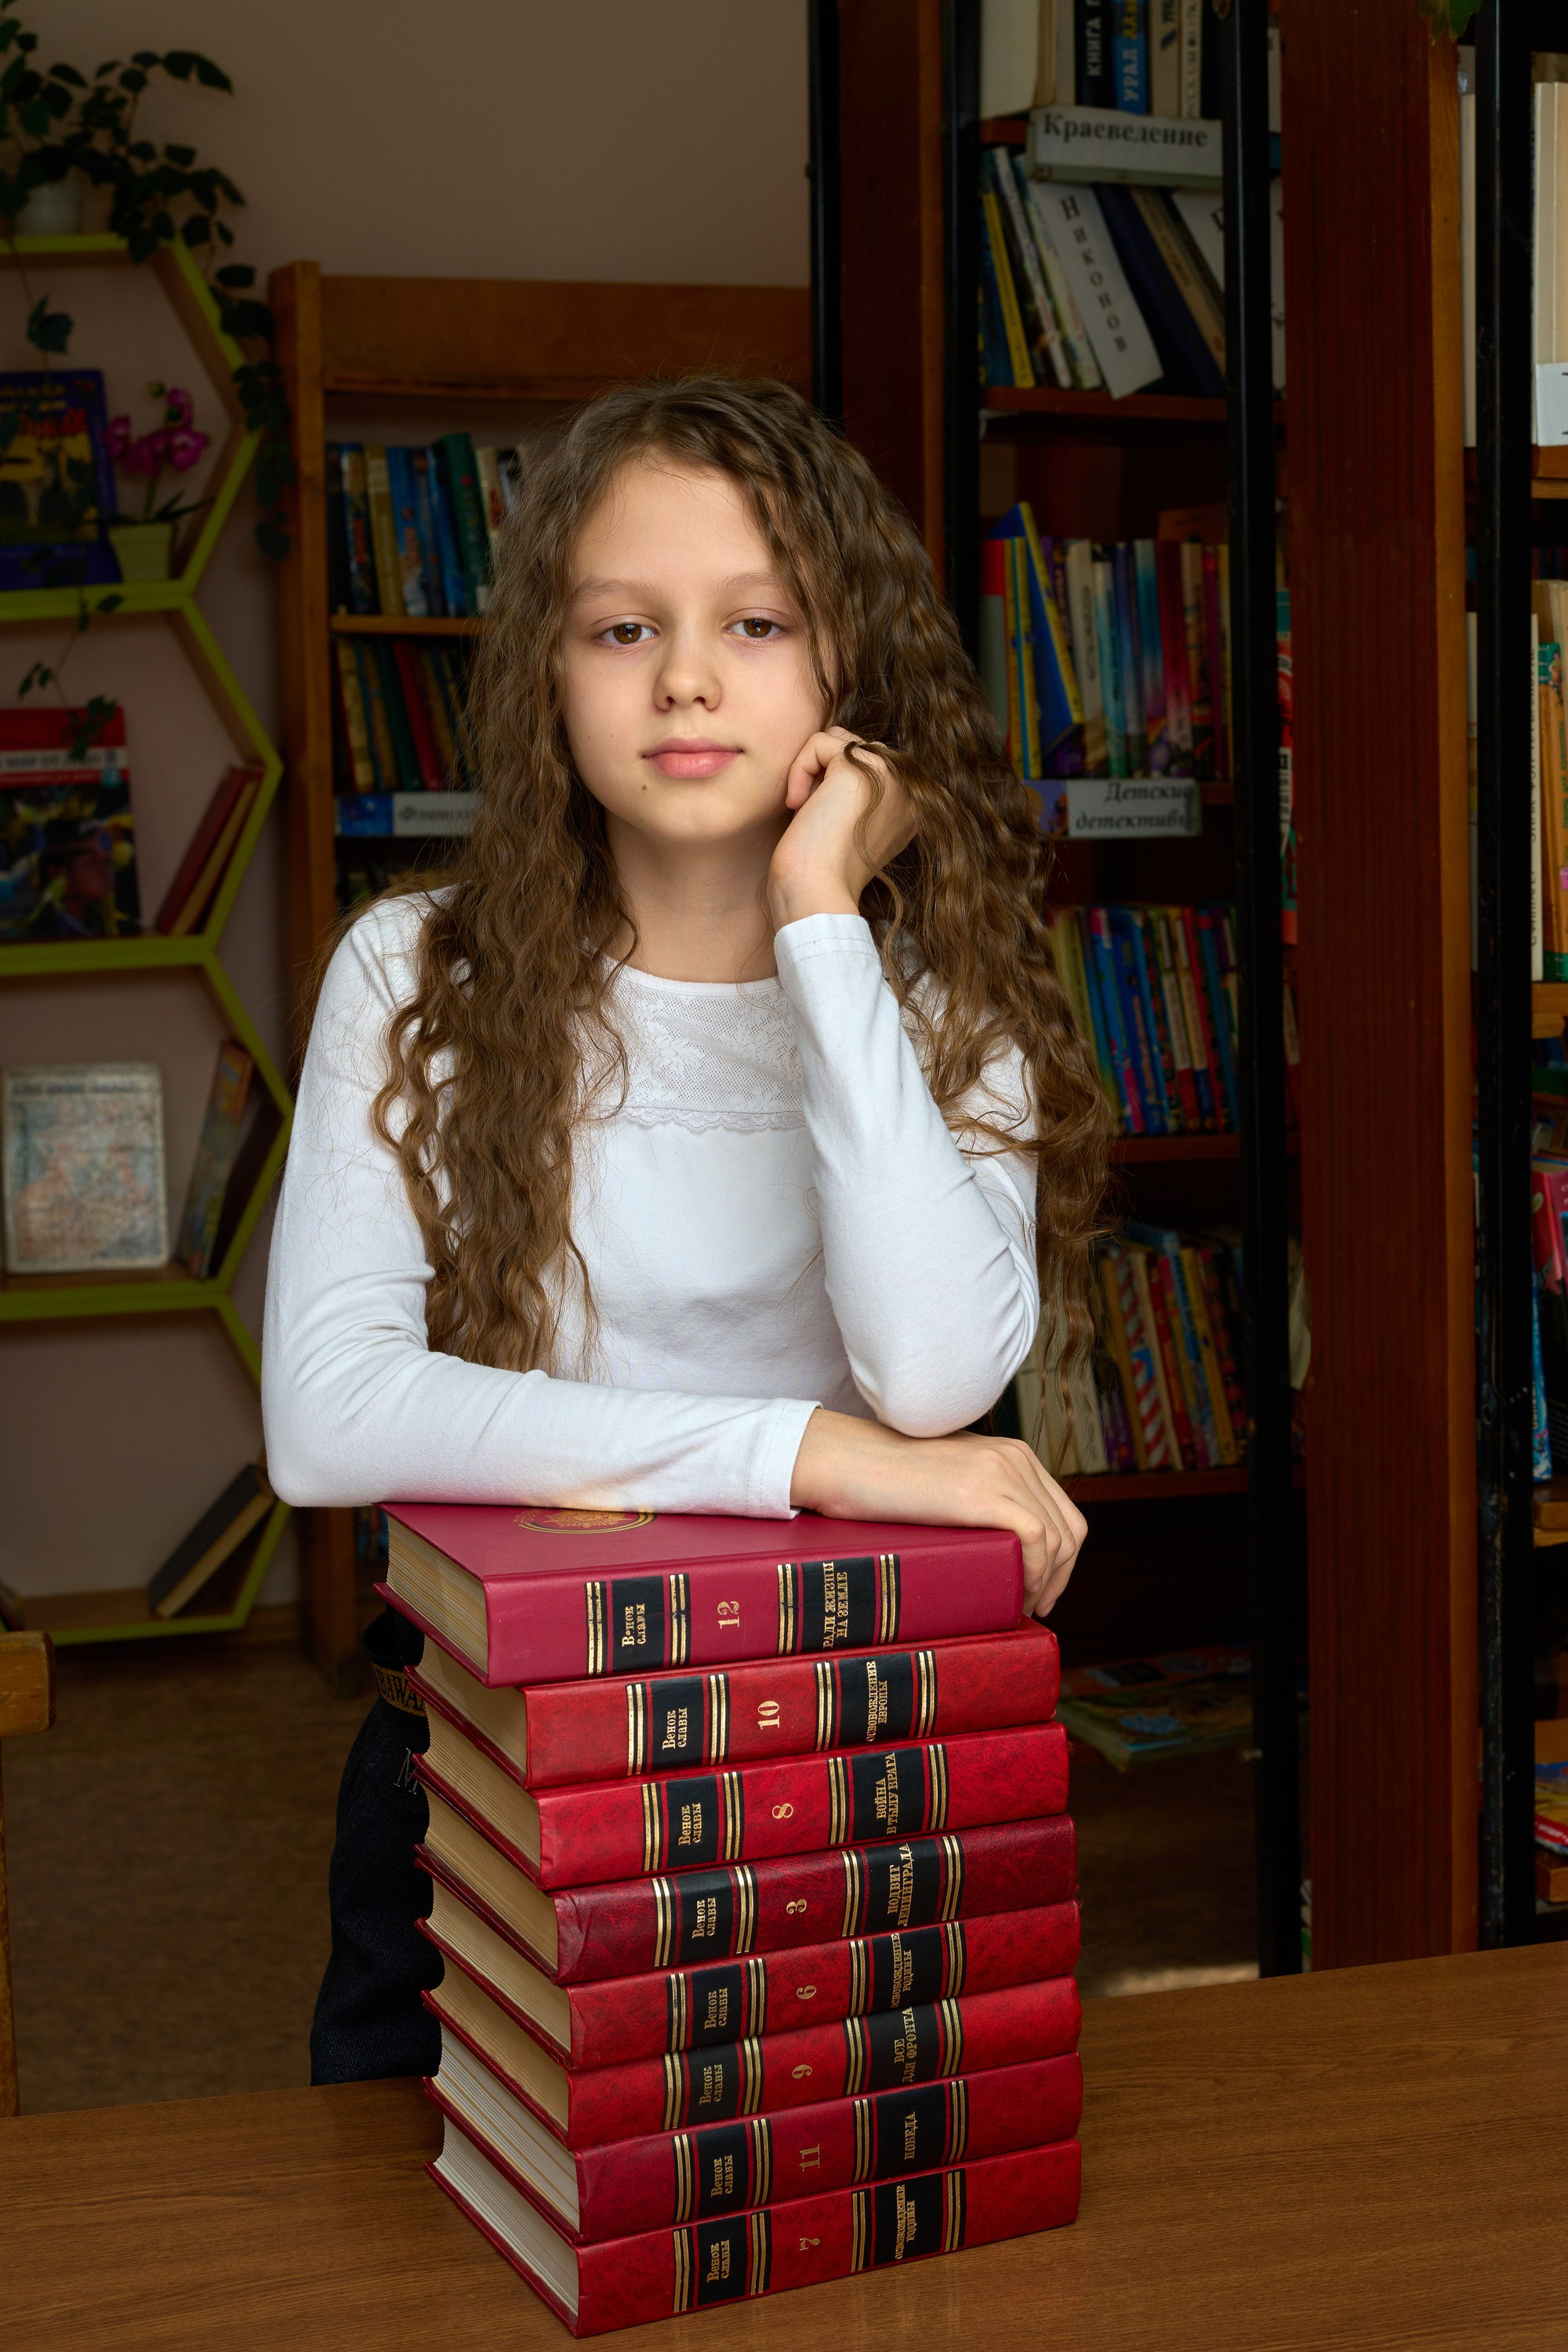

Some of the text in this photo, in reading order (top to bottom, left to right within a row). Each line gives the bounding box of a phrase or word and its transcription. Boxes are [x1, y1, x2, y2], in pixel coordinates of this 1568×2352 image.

[1086, 17, 1102, 76] КНИГА
[1122, 49, 1140, 101] УРАЛ
[1044, 114, 1208, 147] Краеведение
[1062, 195, 1127, 352] Никонов
[1104, 782, 1195, 803] Детские
[717, 1601, 739, 1628] 12
[823, 1562, 836, 1650] РАДИ ЖИЗНИ
[837, 1572, 848, 1638] НА ЗЕМЛЕ
[758, 1700, 779, 1730] 10
[877, 1681, 887, 1724] ЕВРОПЫ
[662, 1711, 676, 1750] Венок
[678, 1708, 687, 1748] славы
[772, 1803, 793, 1819] 8
[875, 1778, 887, 1818] ВОЙНА
[885, 1751, 898, 1834] В ТЫЛУ ВРАГА
[679, 1806, 691, 1845] Венок
[692, 1802, 702, 1842] славы
[887, 1865, 902, 1915] ПОДВИГ
[897, 1843, 914, 1926] ЛЕНИНГРАДА
[692, 1900, 706, 1938] Венок
[707, 1897, 716, 1936] славы
[786, 1900, 807, 1914] 3
[901, 1950, 913, 1991] РОДИНЫ
[705, 1991, 717, 2029] Венок
[719, 1987, 728, 2026] славы
[797, 1985, 816, 1999] 6
[895, 2038, 905, 2063] ВСЕ
[902, 2007, 916, 2082] ДЛЯ ФРОНТА
[699, 2067, 712, 2104] Венок
[714, 2064, 723, 2101] славы
[792, 2064, 812, 2078] 9
[905, 2111, 917, 2159] ПОБЕДА
[724, 2154, 733, 2194] славы
[800, 2143, 819, 2172] 11
[711, 2158, 722, 2197] Венок
[895, 2185, 906, 2259] ОСВОБОЖДЕНИЕ
[906, 2200, 916, 2241] РОДИНЫ
[707, 2243, 720, 2282] Венок
[719, 2239, 730, 2278] славы
[800, 2238, 820, 2250] 7
